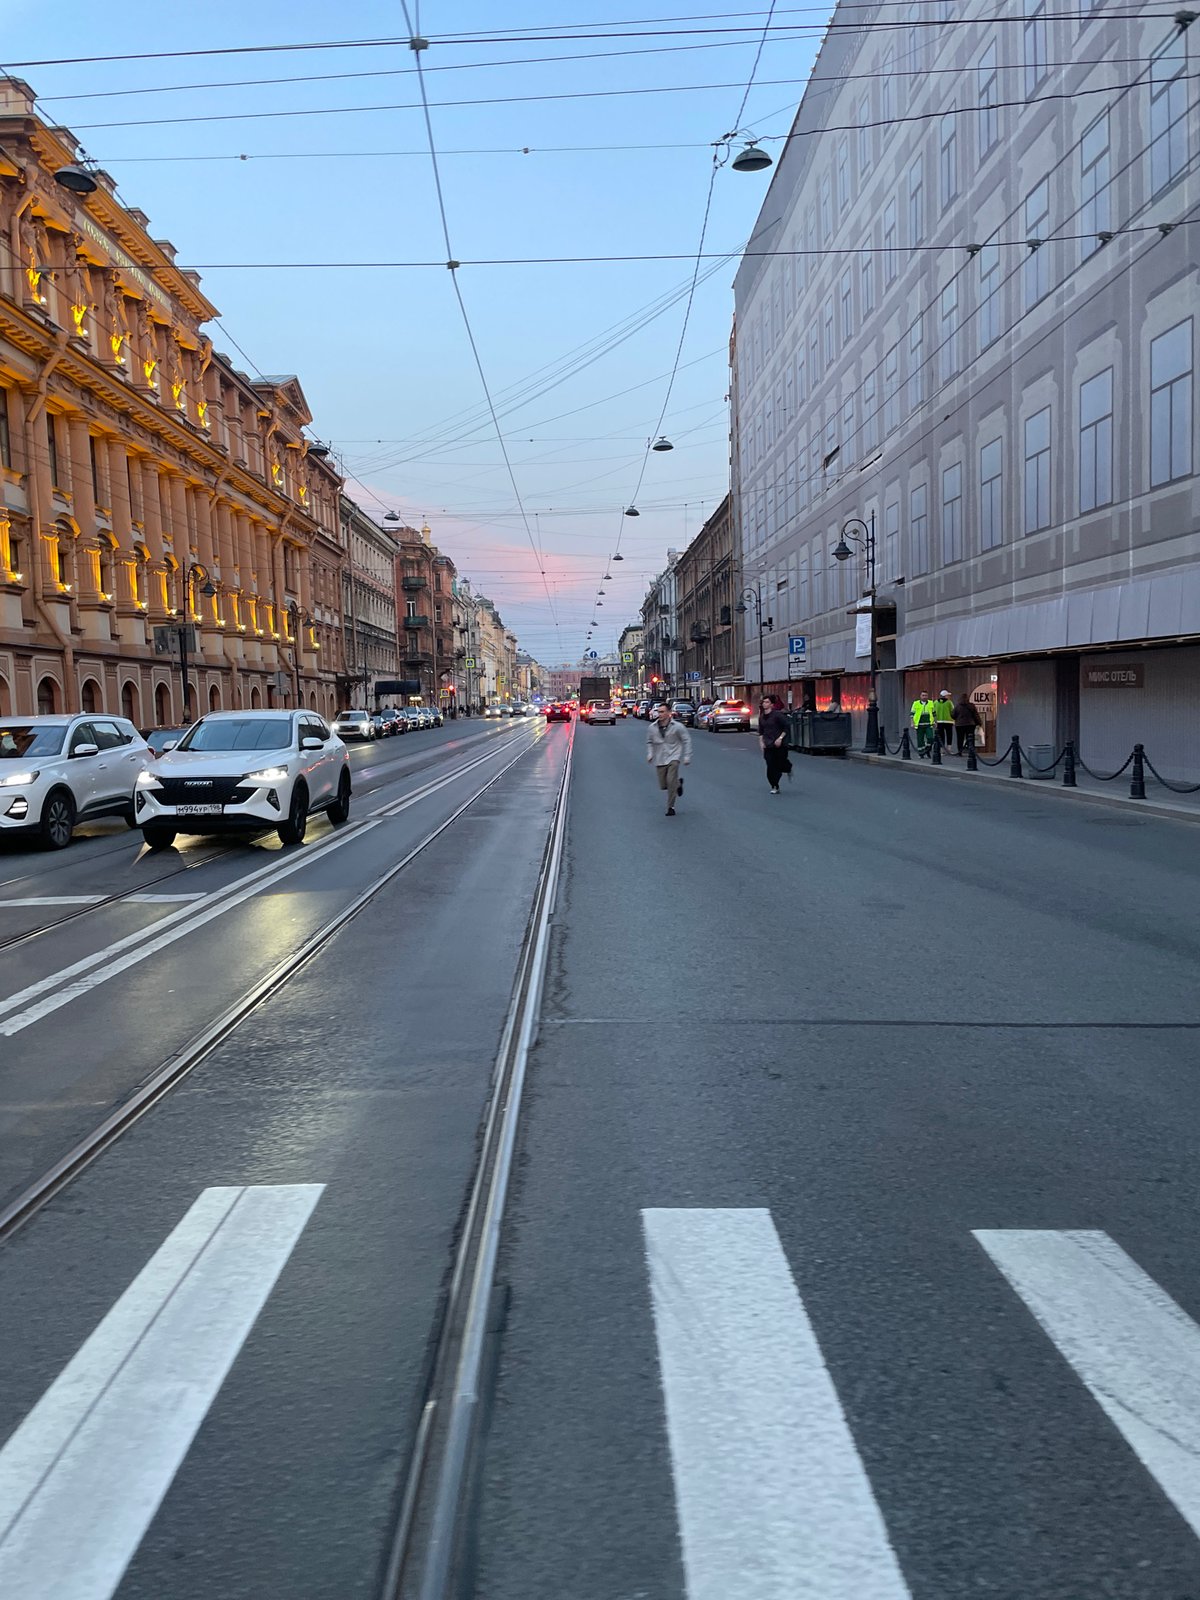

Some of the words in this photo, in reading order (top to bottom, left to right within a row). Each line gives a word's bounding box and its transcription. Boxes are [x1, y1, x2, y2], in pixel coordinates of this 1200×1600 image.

[1088, 671, 1110, 682] МИКС
[1110, 670, 1137, 682] ОТЕЛЬ
[974, 692, 990, 703] ЦЕХ
